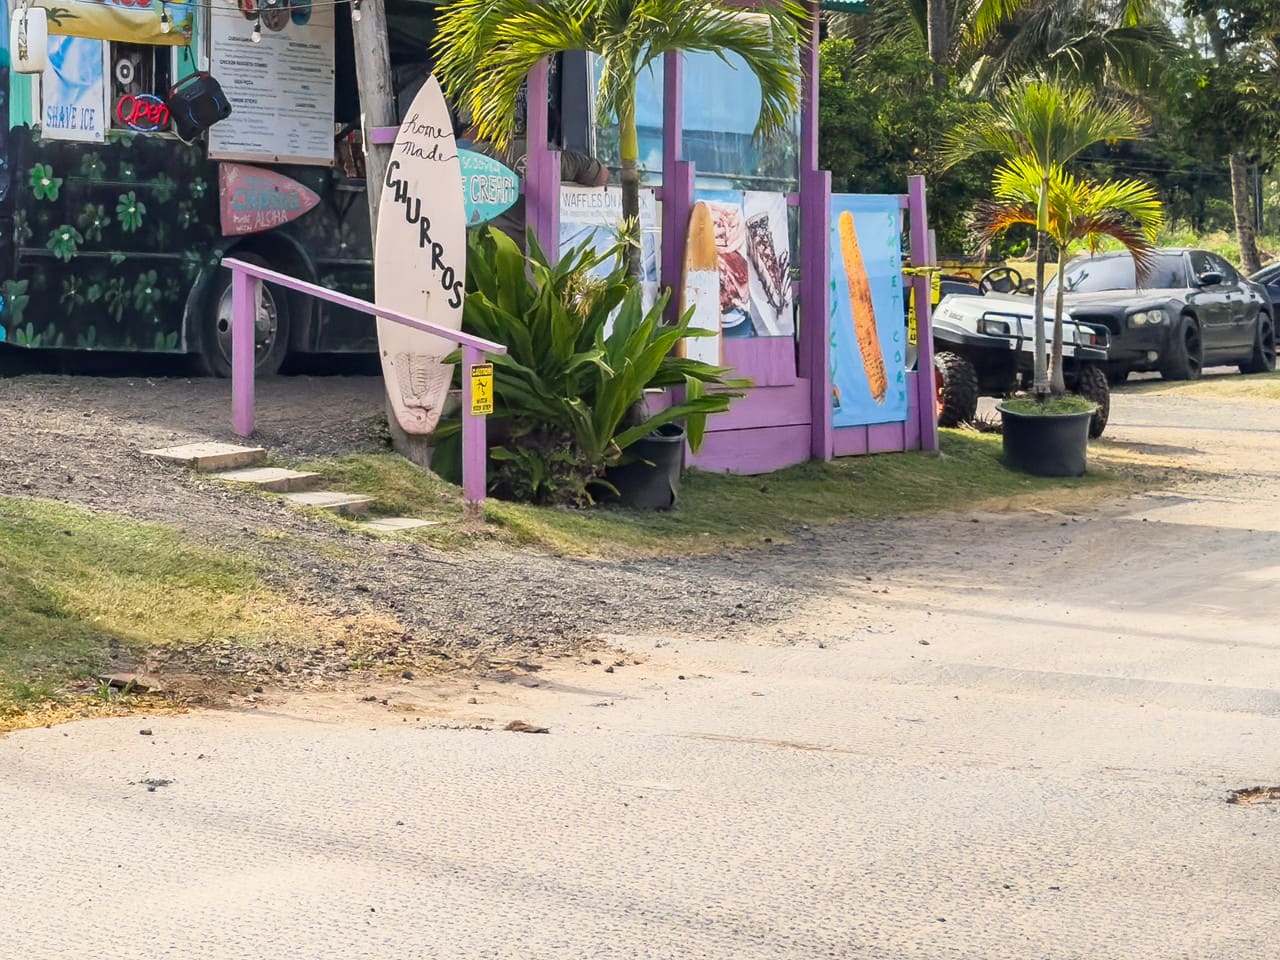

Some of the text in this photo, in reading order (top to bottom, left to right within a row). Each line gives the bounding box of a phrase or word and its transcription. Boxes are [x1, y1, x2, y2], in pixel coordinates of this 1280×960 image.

[46, 105, 96, 131] SHAVE ICE
[116, 95, 170, 127] Open
[470, 174, 514, 203] CREAM
[562, 192, 617, 208] WAFFLES ON
[386, 160, 463, 309] CHURROS
